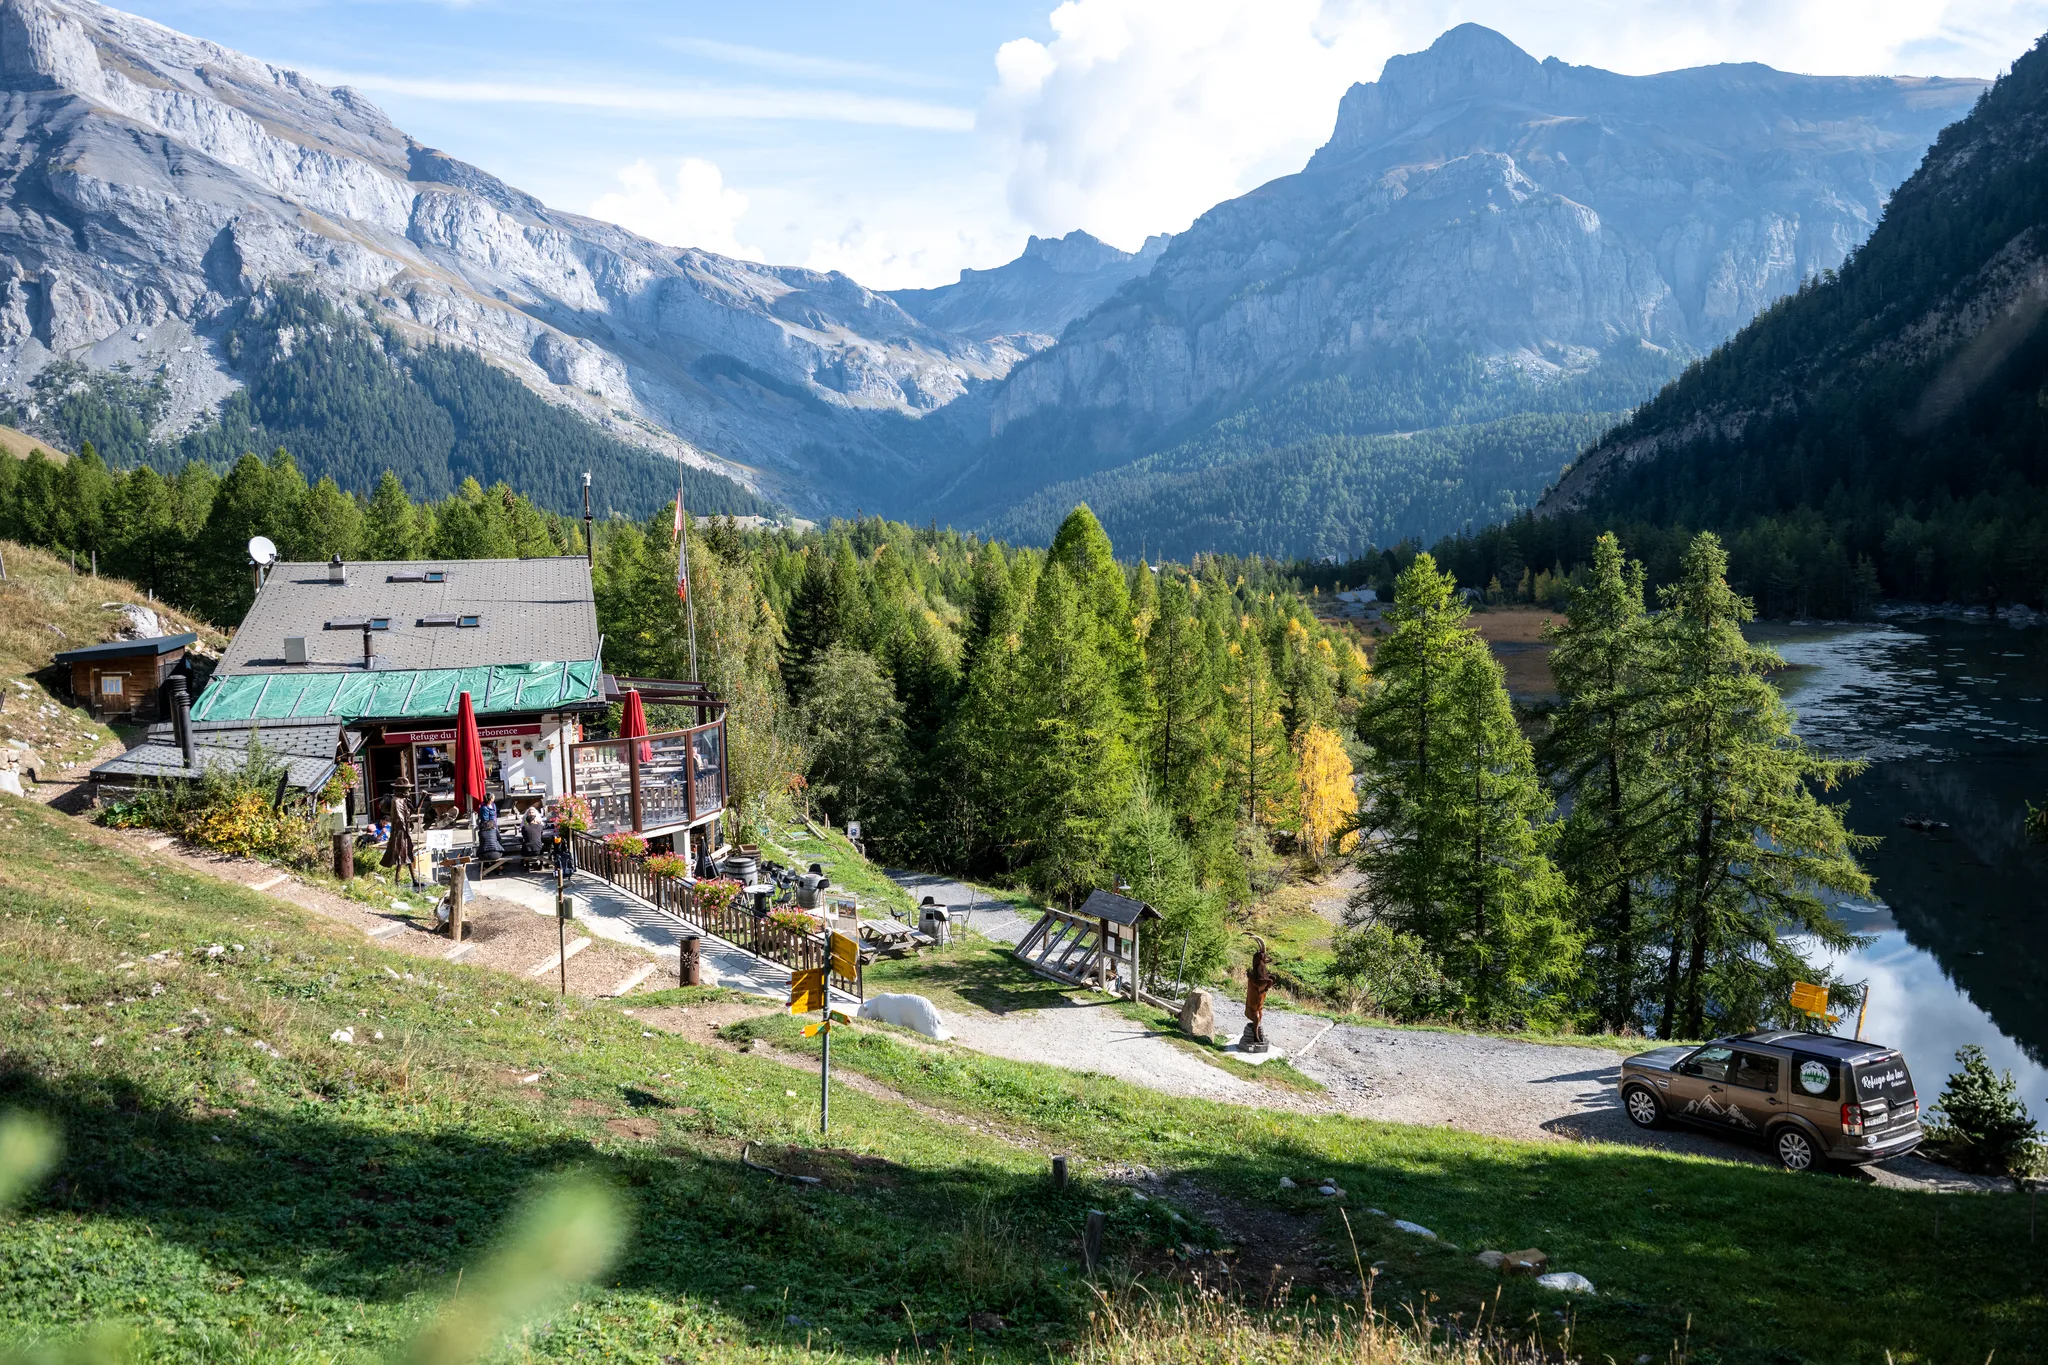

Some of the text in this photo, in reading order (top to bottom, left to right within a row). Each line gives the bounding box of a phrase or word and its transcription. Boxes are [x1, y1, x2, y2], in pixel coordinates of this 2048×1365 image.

[410, 732, 439, 742] Refuge
[440, 731, 452, 740] du
[478, 728, 518, 737] erborence
[1861, 1068, 1905, 1090] Refuge du lac
